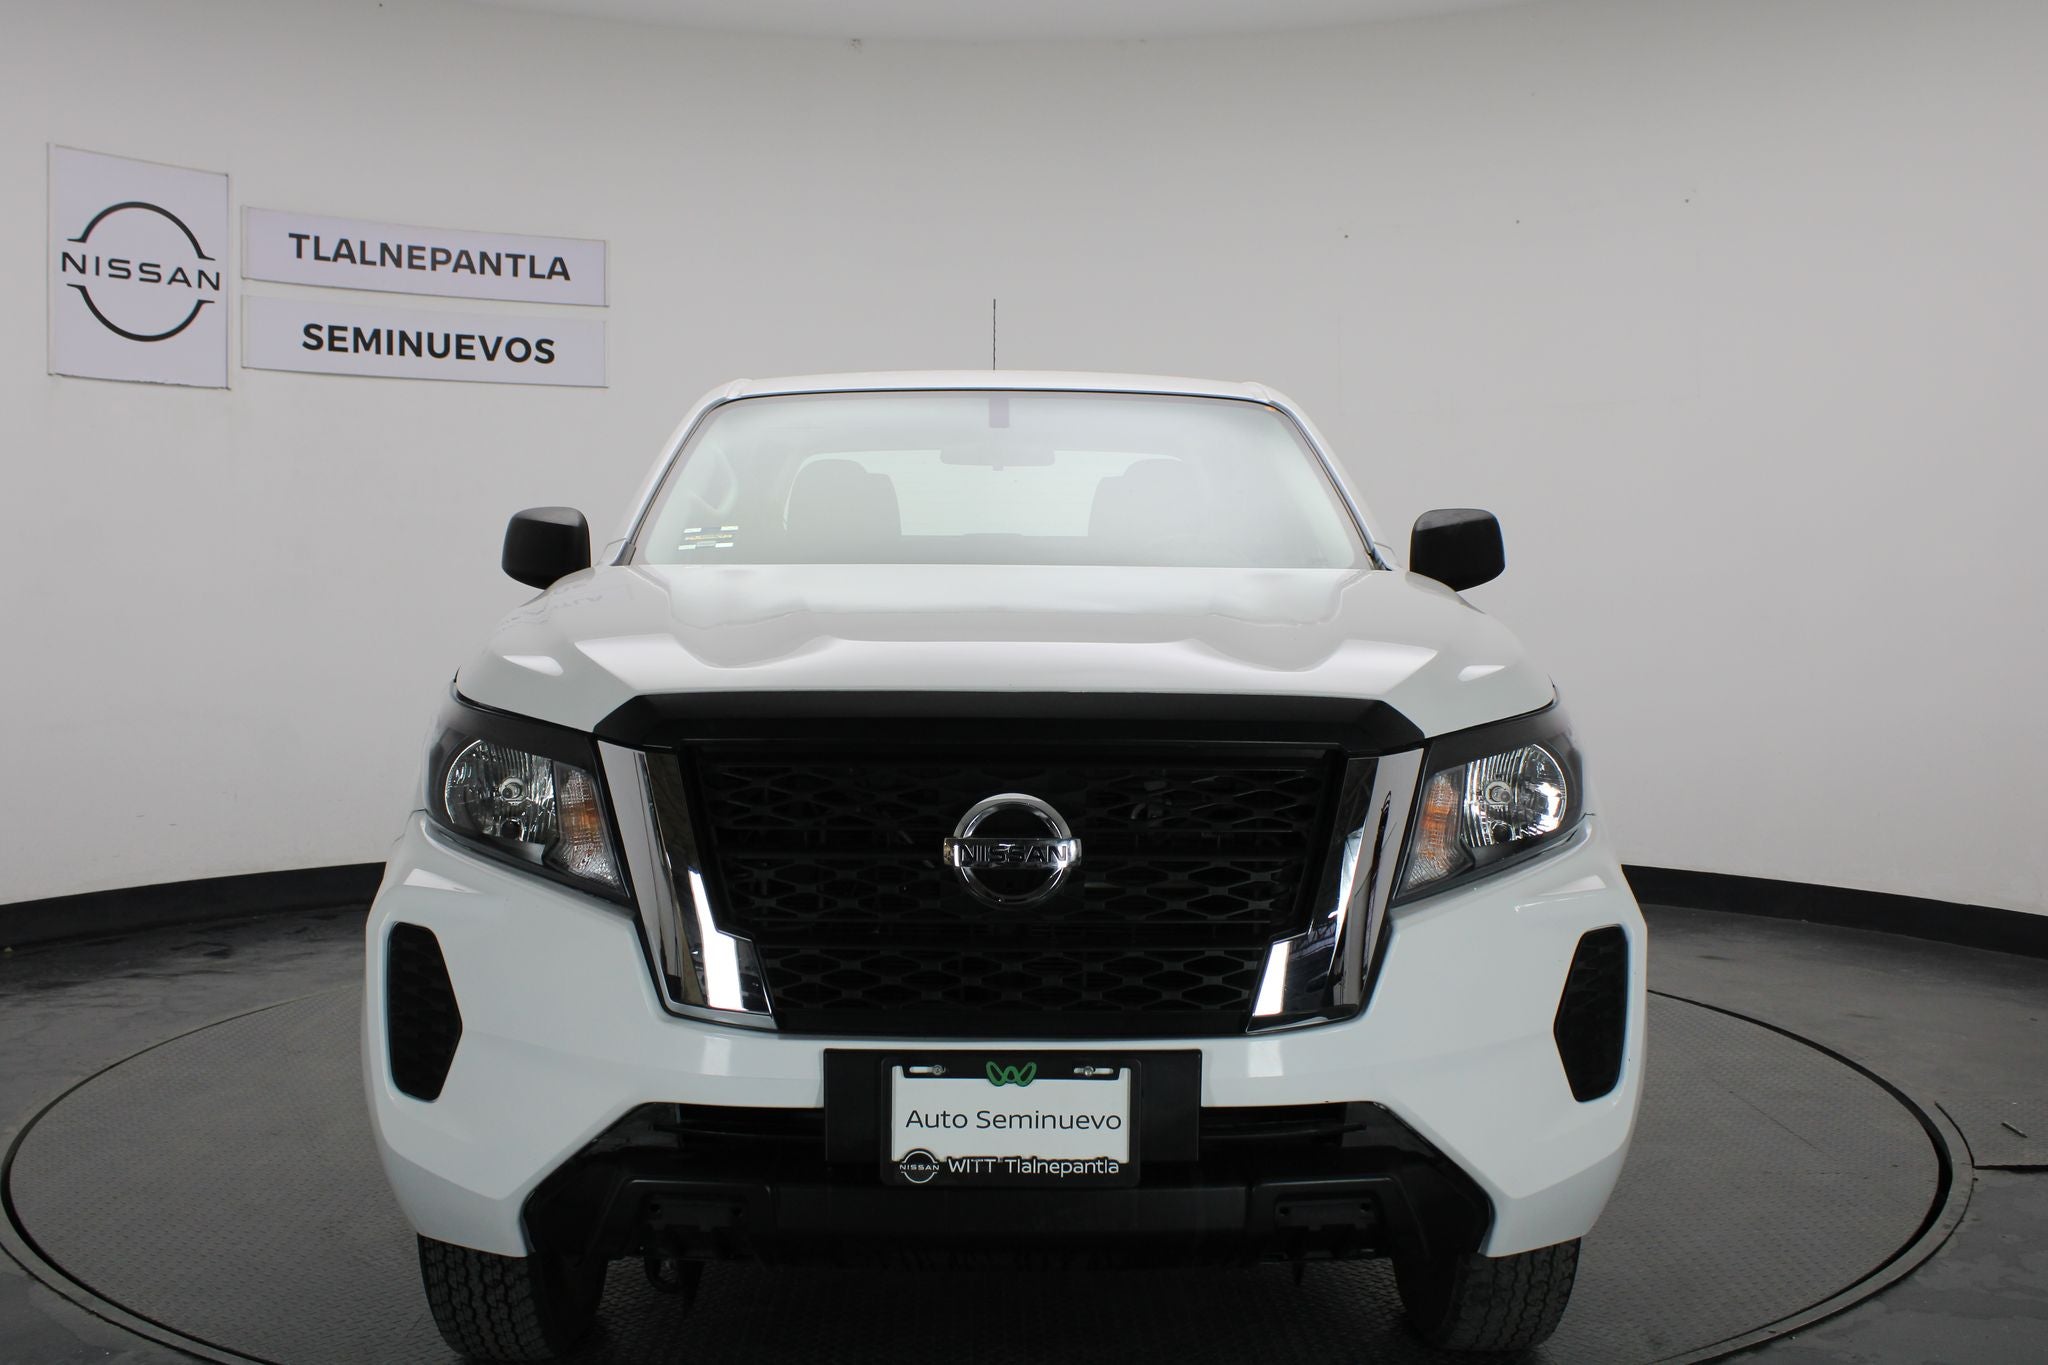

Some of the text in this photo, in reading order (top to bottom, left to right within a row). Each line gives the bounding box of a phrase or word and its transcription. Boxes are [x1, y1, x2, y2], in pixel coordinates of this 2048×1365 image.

[288, 232, 571, 282] TLALNEPANTLA
[61, 250, 221, 292] NISSAN
[301, 322, 556, 365] SEMINUEVOS
[960, 842, 1068, 865] NISSAN
[905, 1109, 1122, 1130] Auto Seminuevo
[899, 1164, 940, 1172] NISSAN
[947, 1157, 1120, 1178] WITT Tlalnepantla
